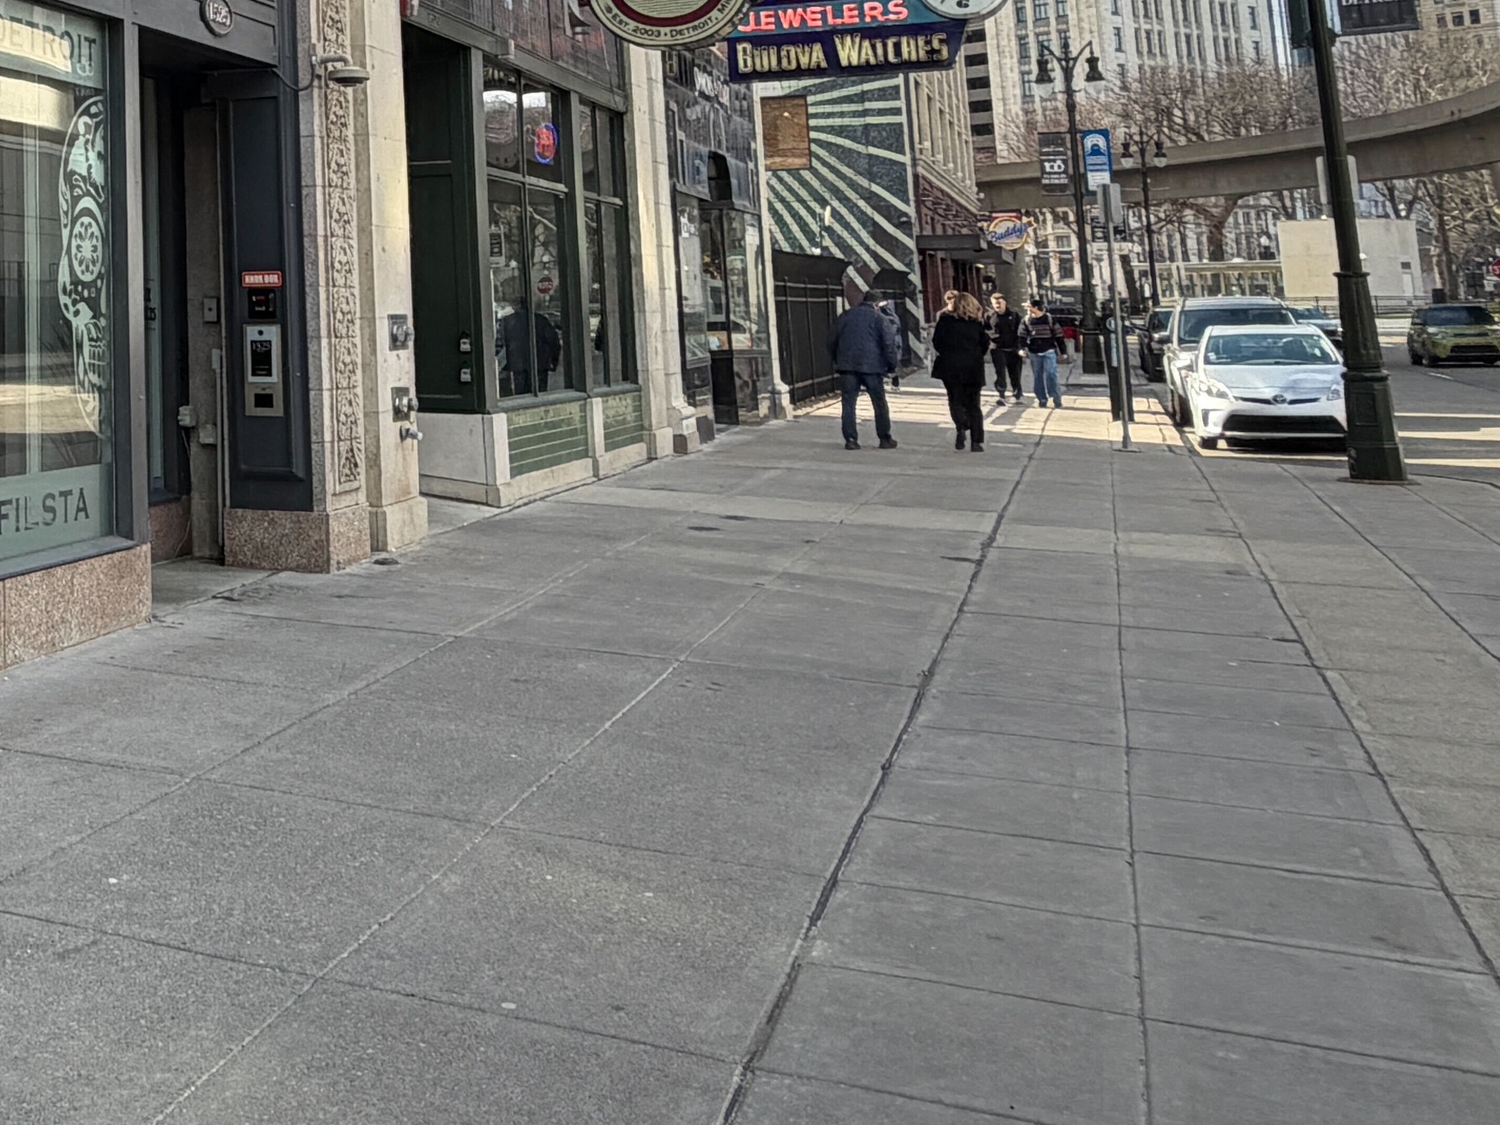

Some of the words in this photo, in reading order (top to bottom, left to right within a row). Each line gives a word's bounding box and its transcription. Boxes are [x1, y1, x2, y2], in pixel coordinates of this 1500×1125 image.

[956, 0, 971, 9] 6
[737, 0, 909, 32] JEWELERS
[632, 25, 662, 38] 2003
[736, 41, 828, 74] BULOVA
[833, 33, 950, 68] WATCHES
